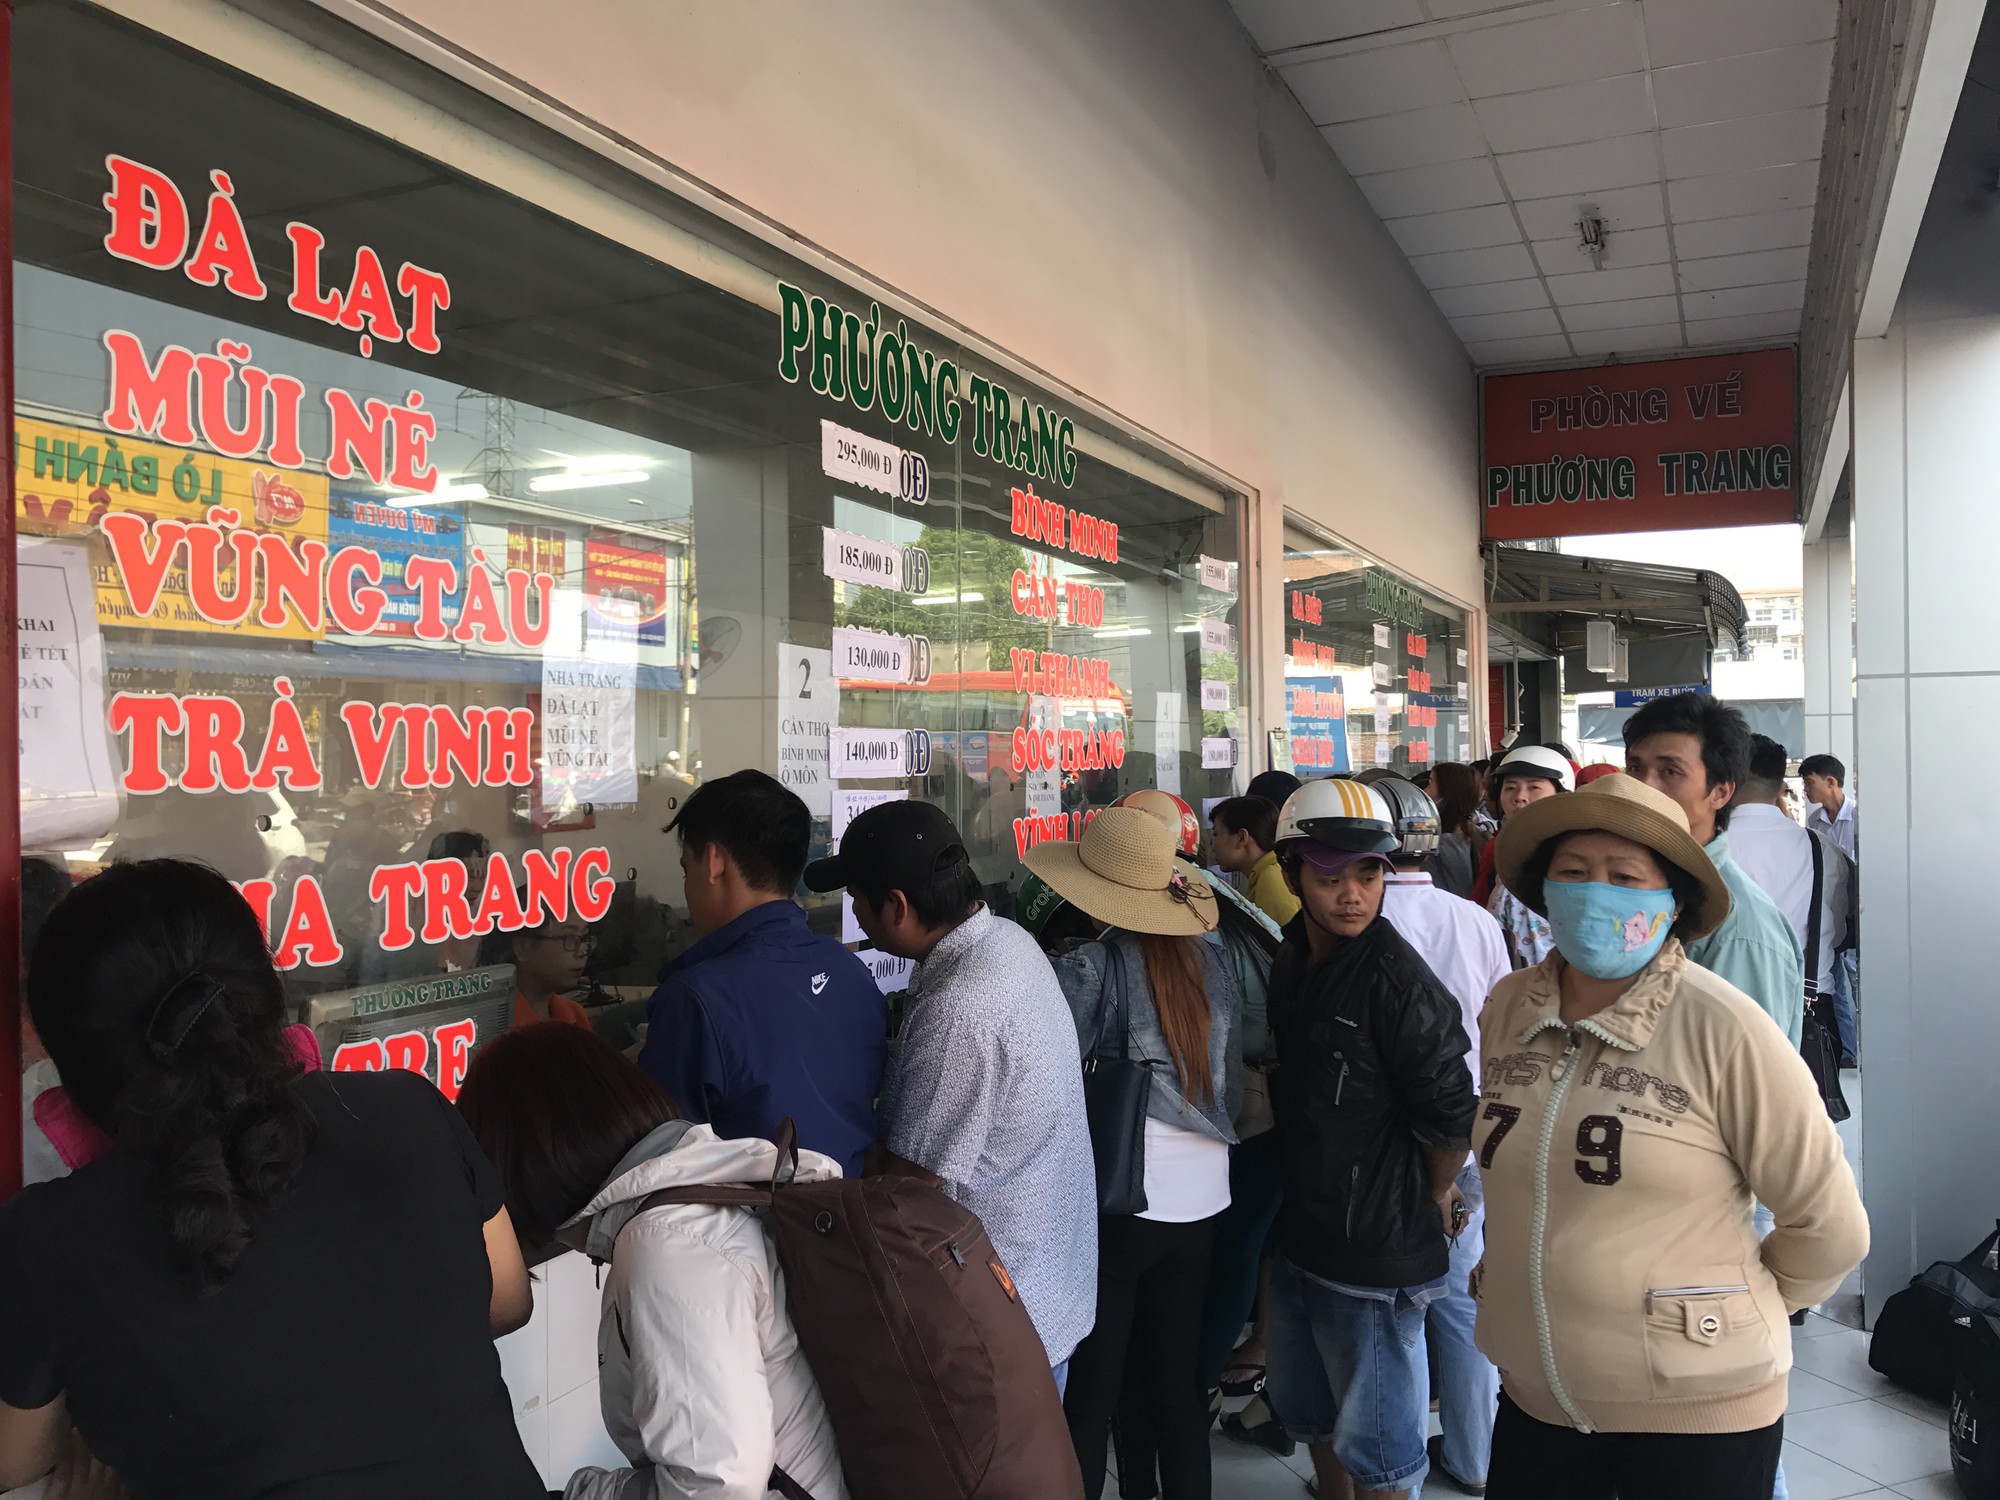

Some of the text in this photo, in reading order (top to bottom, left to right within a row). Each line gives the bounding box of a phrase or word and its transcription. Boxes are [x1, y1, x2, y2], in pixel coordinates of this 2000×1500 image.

[103, 154, 450, 358] ĐÀ LẠT
[777, 280, 1077, 488] PHƯƠNG TRANG
[1530, 370, 1742, 433] PHÒNG VÉ
[103, 329, 438, 494] MŨI NÉ
[838, 439, 892, 475] 295,000 Đ
[1487, 445, 1791, 508] PHƯƠNG TRANG
[1011, 483, 1118, 564] BÌNH MINH
[101, 505, 556, 648] VŨNG TÀU
[840, 545, 893, 575] 185,000 Đ
[1011, 554, 1104, 629] CẦN THƠ
[547, 670, 621, 689] NHA TRANG
[798, 658, 813, 699] 2
[847, 646, 900, 671] 130,000 Đ
[1010, 647, 1110, 706] VỊ THANH
[546, 694, 599, 719] ĐÀ LẠT
[1658, 688, 1670, 697] XE
[109, 676, 534, 795] TRÀ VINH
[547, 725, 598, 744] MŨI NÉ
[547, 748, 612, 767] VŨNG TÀU
[781, 744, 805, 762] BÌNH
[846, 741, 898, 764] 140,000 Đ
[1012, 715, 1125, 772] SÓC TRĂNG
[792, 765, 818, 785] MÔN
[370, 846, 616, 951] TRANG
[352, 972, 492, 1016] PHƯƠNG TRANG
[811, 972, 826, 986] NIKE
[1480, 1102, 1522, 1170] 7
[1574, 1114, 1624, 1186] 9
